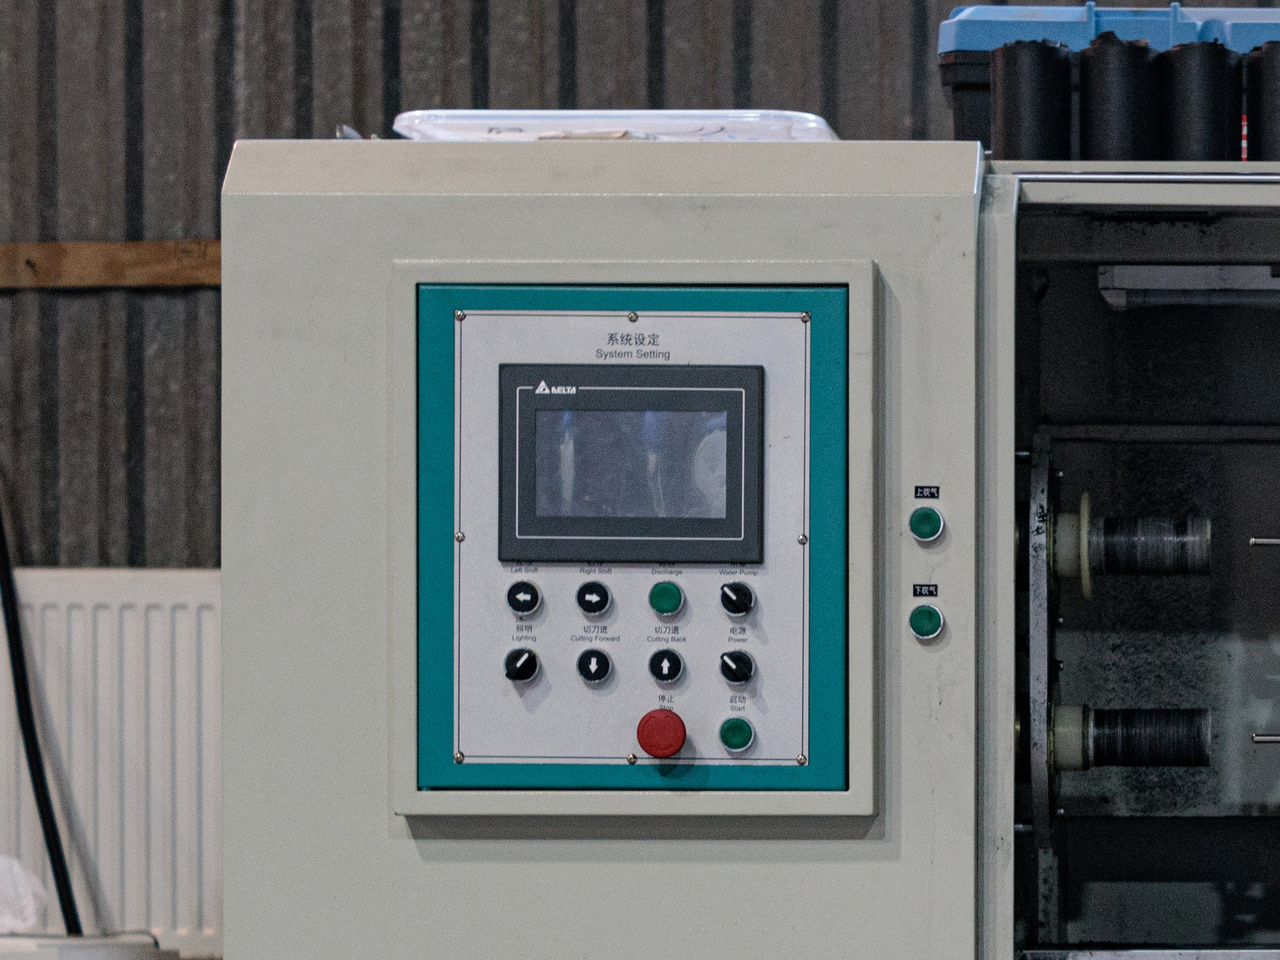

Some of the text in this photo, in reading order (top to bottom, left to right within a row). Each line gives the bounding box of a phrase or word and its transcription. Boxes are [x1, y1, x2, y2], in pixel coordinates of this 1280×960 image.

[607, 333, 660, 346] 系统设定
[596, 349, 671, 361] System Setting
[551, 386, 576, 394] DELTA
[579, 567, 596, 576] Right
[651, 568, 683, 576] Discharge
[739, 569, 758, 577] Pump
[570, 635, 593, 643] Cutting
[647, 635, 670, 643] Cutting
